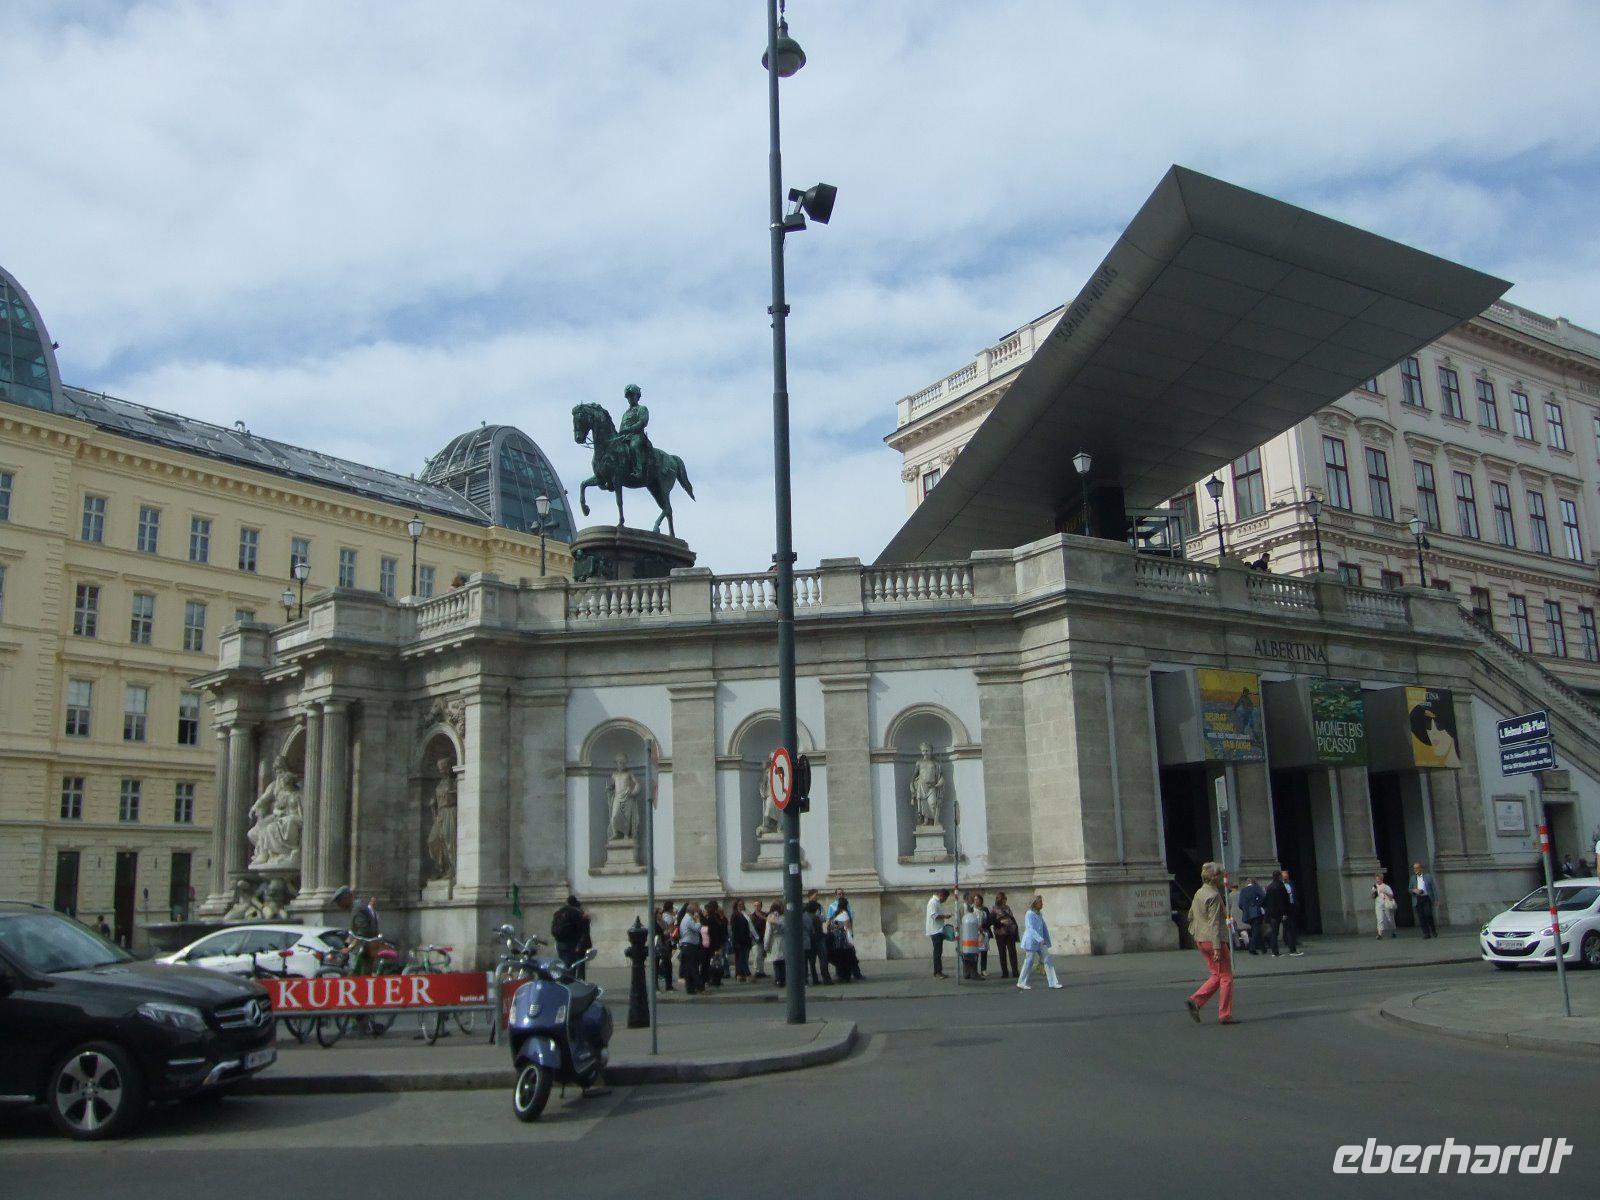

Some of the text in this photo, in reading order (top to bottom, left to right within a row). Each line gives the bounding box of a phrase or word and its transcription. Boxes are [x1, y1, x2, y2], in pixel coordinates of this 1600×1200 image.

[1254, 640, 1328, 661] ALBERTINA
[1315, 720, 1364, 738] MONET BIS
[1317, 736, 1357, 753] PICASSO
[277, 976, 434, 1008] KURIER
